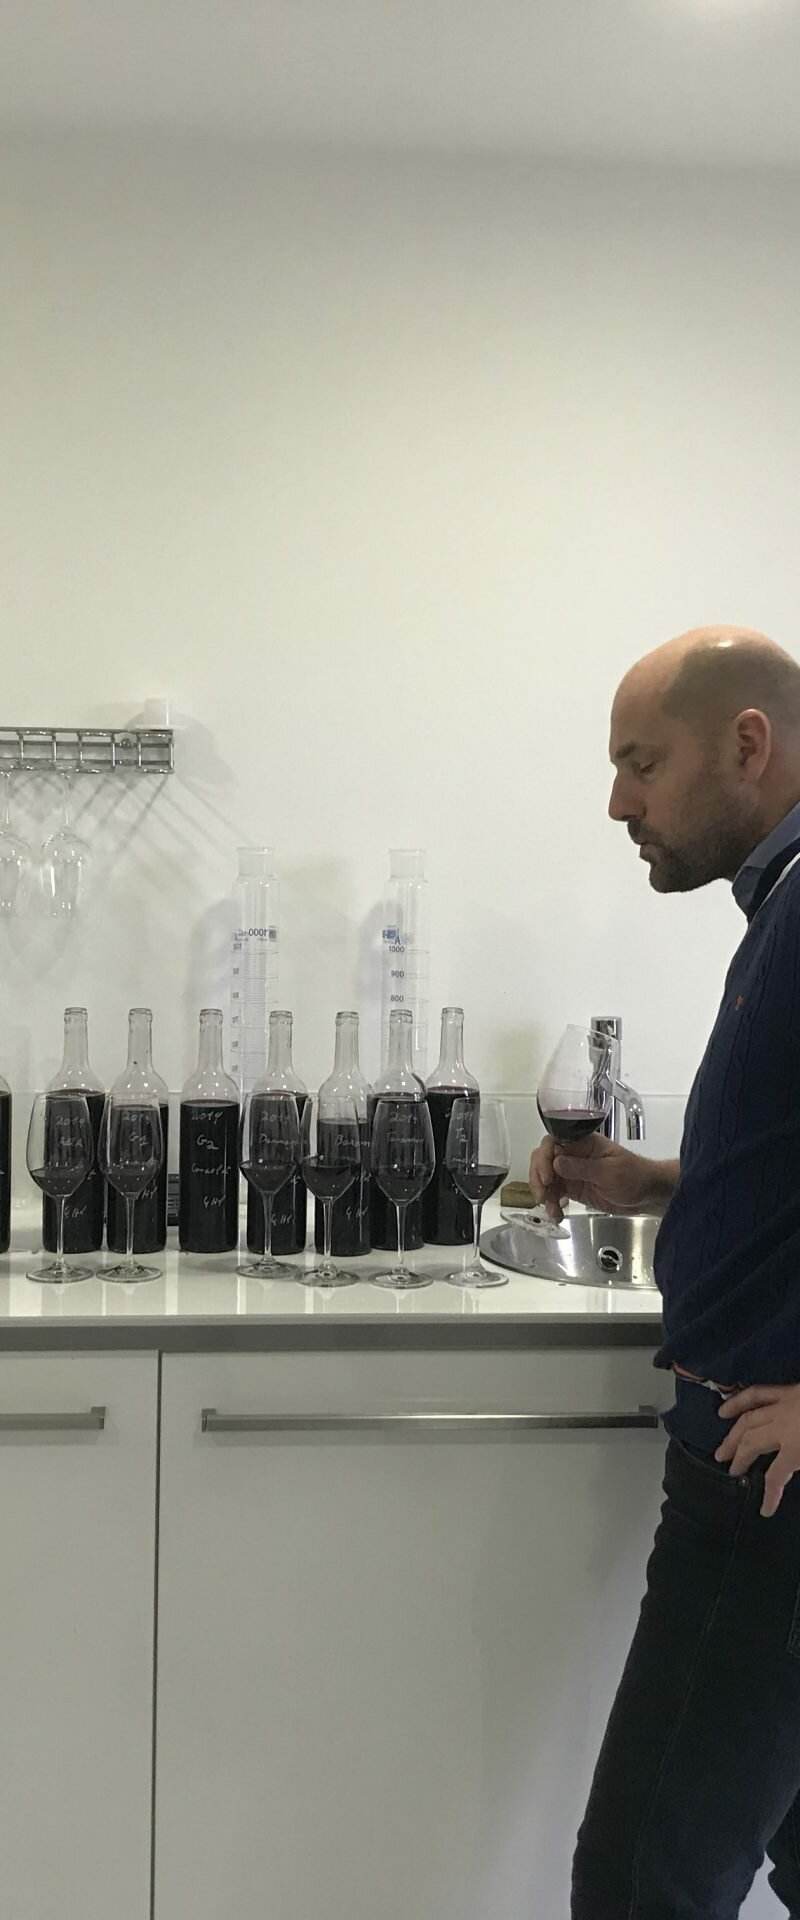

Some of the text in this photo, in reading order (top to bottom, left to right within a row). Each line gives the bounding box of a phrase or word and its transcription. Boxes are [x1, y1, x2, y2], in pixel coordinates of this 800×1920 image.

[389, 945, 405, 953] 1000
[391, 970, 405, 978] 900
[391, 994, 405, 1002] 800
[196, 1133, 220, 1150] G2
